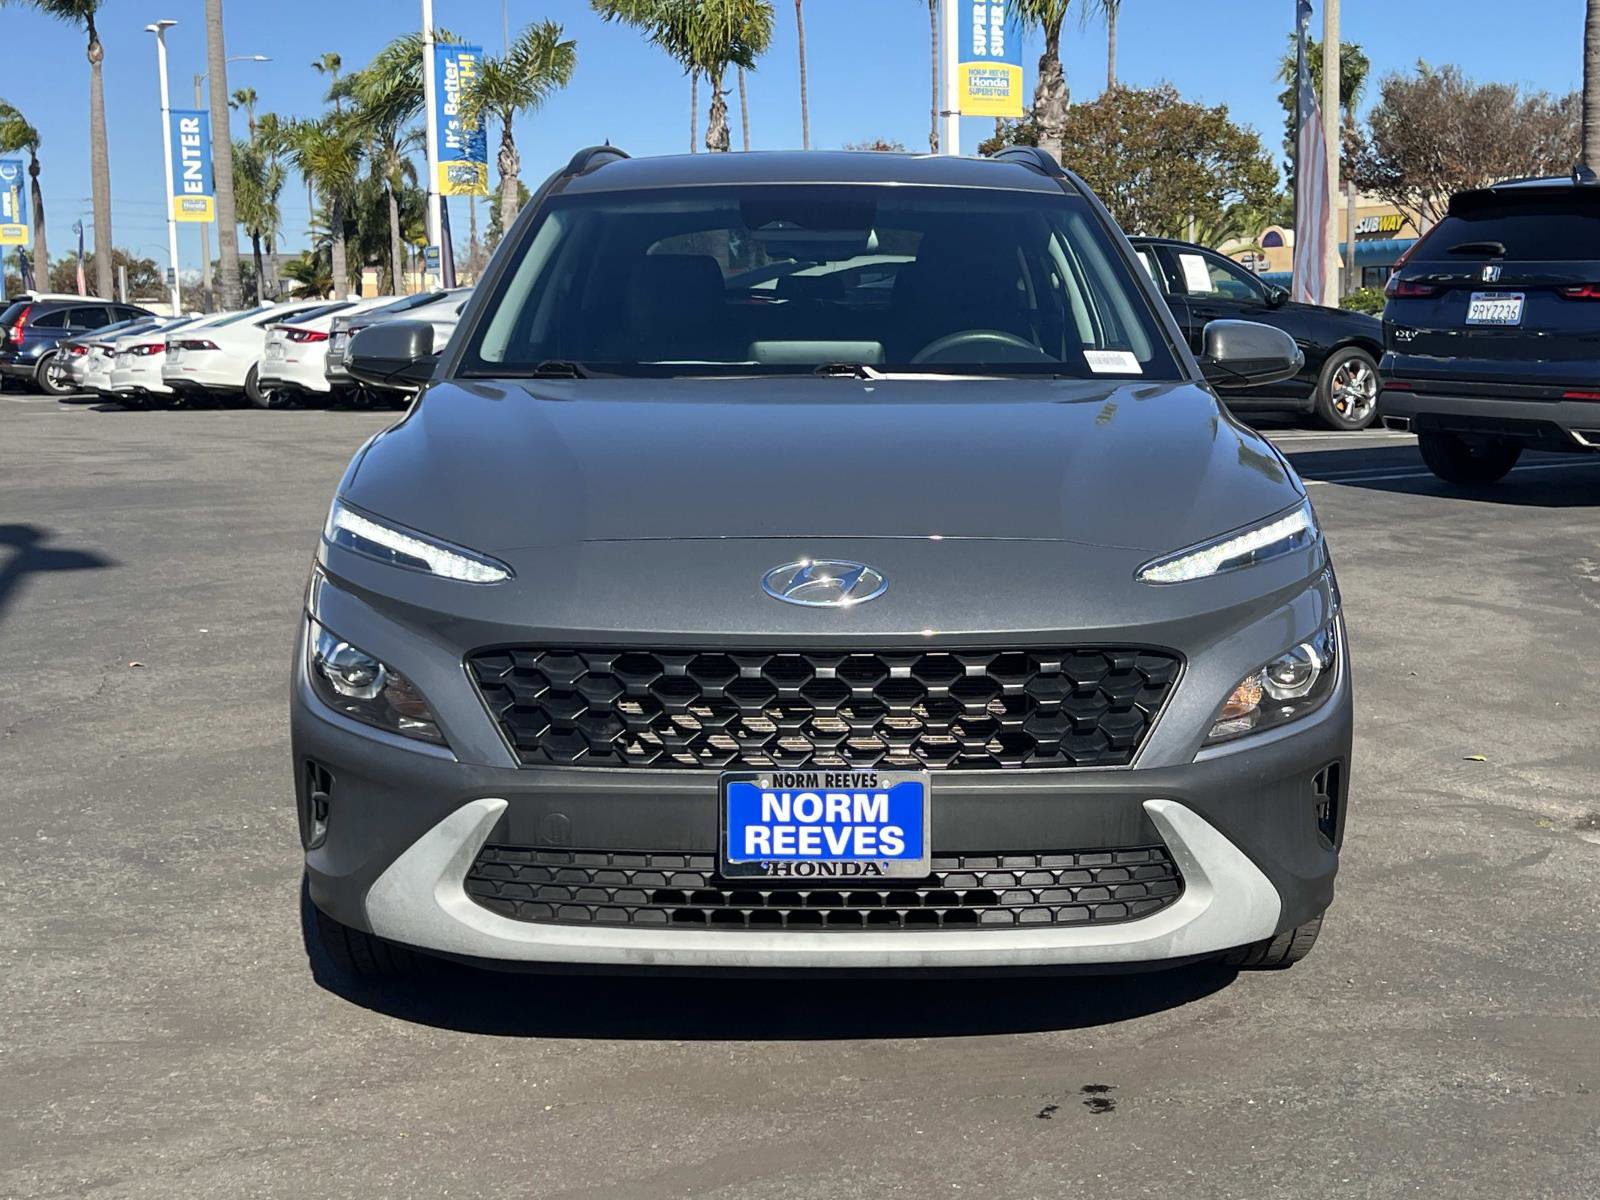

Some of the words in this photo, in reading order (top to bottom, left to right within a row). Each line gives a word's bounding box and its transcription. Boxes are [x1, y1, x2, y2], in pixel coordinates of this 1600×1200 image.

[973, 4, 986, 56] SUPER
[991, 5, 1004, 57] SUPER
[444, 58, 459, 116] Better
[969, 87, 1009, 96] SUPERSTORE
[970, 77, 1008, 87] Honda
[445, 120, 460, 149] It's
[180, 117, 203, 193] ENTER
[1355, 214, 1405, 234] SUBWAY
[1472, 304, 1518, 320] 9RYZ236
[772, 773, 819, 788] NORM
[825, 773, 878, 788] REEVES
[761, 793, 889, 823] NORM
[745, 825, 905, 856] REEVES
[770, 861, 884, 877] HONDA
